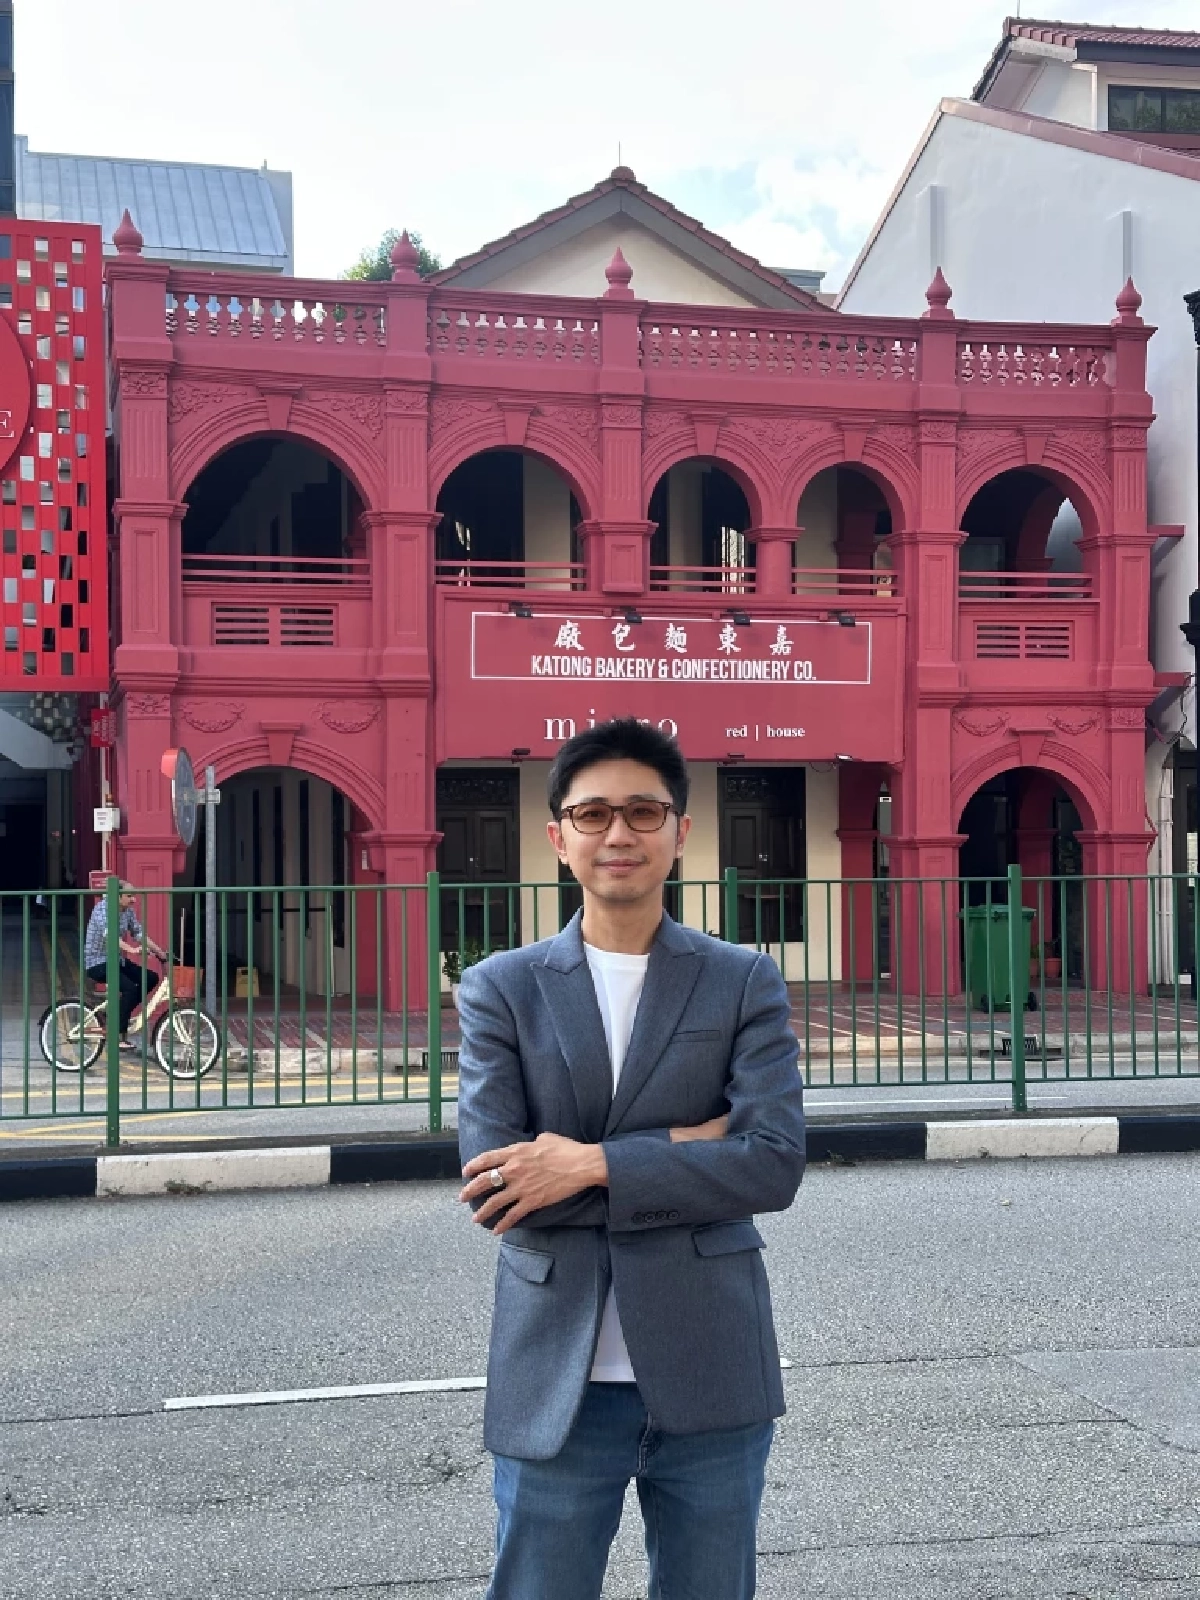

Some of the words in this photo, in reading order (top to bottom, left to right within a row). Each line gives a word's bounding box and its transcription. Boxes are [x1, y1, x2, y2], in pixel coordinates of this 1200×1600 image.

[531, 655, 592, 676] KATONG
[595, 657, 656, 678] BAKERY
[658, 658, 669, 678] &
[671, 658, 792, 680] CONFECTIONERY
[794, 660, 817, 681] CO.
[543, 708, 678, 741] mio
[725, 724, 748, 738] red
[766, 724, 806, 738] house
